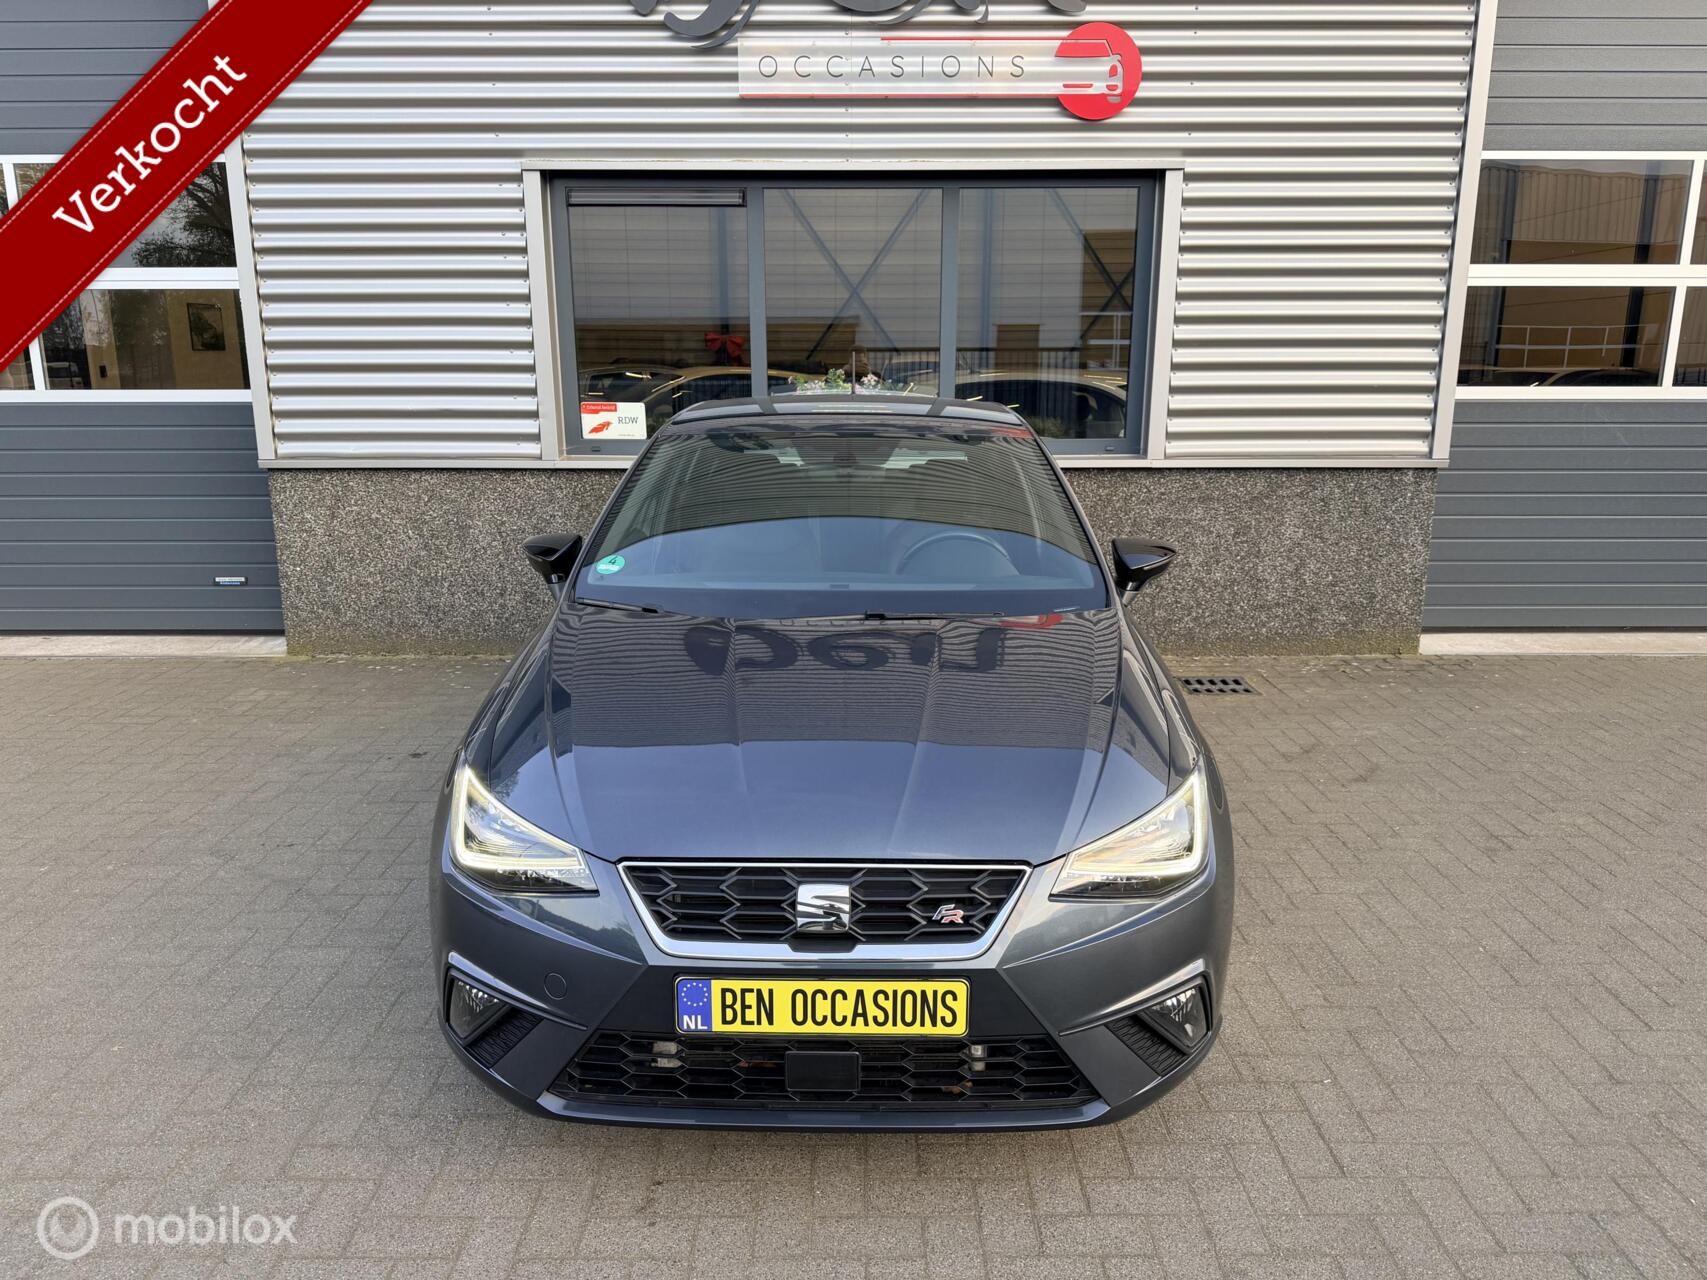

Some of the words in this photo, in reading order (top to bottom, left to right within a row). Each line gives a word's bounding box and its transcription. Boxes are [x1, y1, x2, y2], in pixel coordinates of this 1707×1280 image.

[758, 55, 1025, 78] OCCASIONS
[617, 416, 639, 425] RDW
[932, 904, 964, 924] FR
[720, 987, 775, 1026] BEN
[791, 988, 958, 1028] OCCASIONS
[683, 1015, 708, 1030] NL
